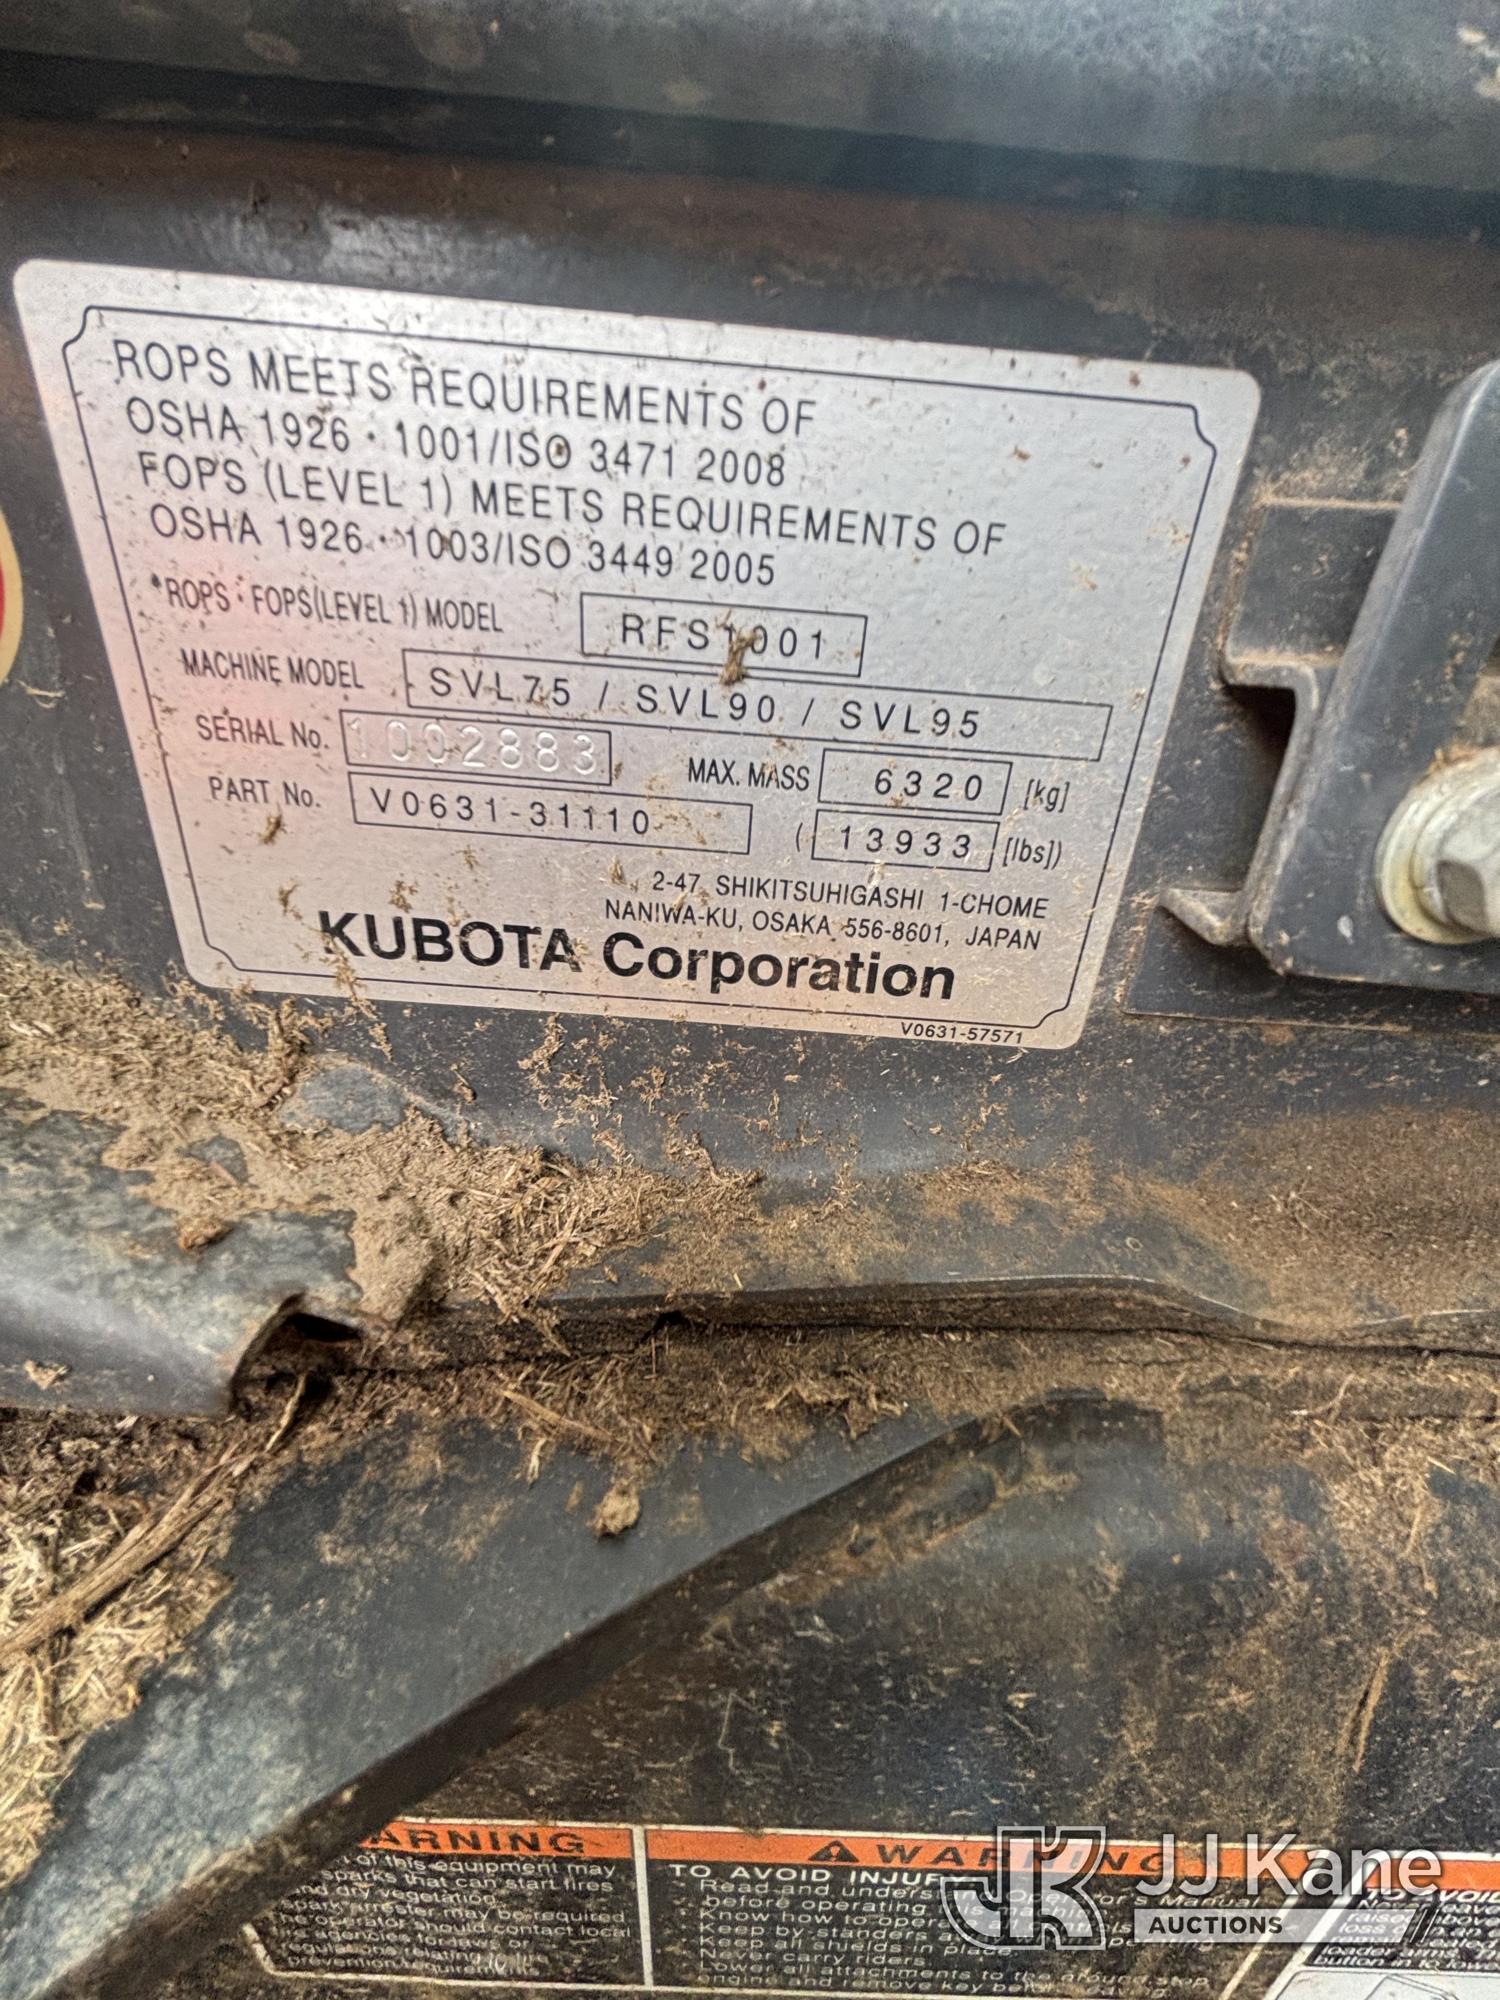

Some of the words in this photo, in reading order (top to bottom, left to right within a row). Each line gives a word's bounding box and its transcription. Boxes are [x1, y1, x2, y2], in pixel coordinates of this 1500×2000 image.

[113, 338, 232, 387] ROPS
[249, 351, 392, 401] MEETS
[411, 366, 743, 432] REQUIREMENTS
[762, 398, 817, 436] OF
[126, 396, 243, 443] OSHA
[261, 409, 351, 453] 1926
[396, 422, 572, 470] 1001/ISO
[591, 439, 675, 479] 3471
[697, 448, 786, 488] 2008
[138, 451, 247, 495] FOPS
[264, 458, 402, 507] (LEVEL
[421, 474, 452, 516] 1)
[472, 479, 604, 523] MEETS
[623, 493, 938, 552] REQUIREMENTS
[954, 520, 1007, 557] OF
[151, 503, 261, 547] OSHA
[277, 516, 362, 554] 1926
[406, 527, 571, 570] 1003/ISO
[587, 540, 673, 577] 3449
[690, 549, 776, 587] 2005
[165, 577, 231, 612] ROPS
[399, 596, 418, 630] 1)
[425, 597, 504, 634] MODEL
[180, 648, 280, 686] MACHINE
[288, 656, 364, 690] MODEL
[430, 666, 571, 707] SVL75
[637, 683, 776, 724] SVL90
[840, 700, 980, 739] SVL95
[195, 714, 284, 747] SERIAL
[291, 722, 329, 750] No.
[348, 717, 598, 775] 1002883
[688, 757, 743, 786] MAX.
[748, 762, 810, 792] MASS
[874, 768, 983, 802] 6320
[1023, 779, 1070, 813] [kg]
[208, 776, 269, 803] PART
[282, 780, 321, 810] No.
[370, 786, 650, 835] V0631-31110
[841, 826, 971, 859] 13933
[652, 870, 700, 893] 2-47
[716, 875, 924, 911] SHIKITSUHIGASHI
[940, 892, 1049, 919] 1-CHOME
[606, 899, 743, 932] NANIWA-KU,
[752, 911, 831, 936] OSAKA
[845, 917, 951, 947] 556-8601,
[965, 926, 1042, 950] JAPAN
[318, 910, 583, 973] KUBOTA
[603, 931, 955, 1000] Corporation
[901, 1021, 1023, 1045] V0631-57571
[370, 1829, 585, 1853] ARNING
[385, 1854, 426, 1870] this
[430, 1861, 558, 1876] equipment
[568, 1864, 615, 1878] may
[669, 1863, 712, 1878] TO
[730, 1866, 832, 1882] AVOID
[320, 1869, 397, 1884] sparks
[404, 1873, 448, 1888] that
[456, 1878, 497, 1889] can
[506, 1876, 557, 1891] start
[564, 1877, 613, 1892] fires
[700, 1879, 769, 1894] Read
[781, 1883, 830, 1897] and
[1159, 1894, 1261, 1908] Manual
[443, 1906, 490, 1921] may
[533, 1909, 625, 1924] required
[700, 1908, 770, 1922] Know
[782, 1911, 833, 1924] how
[844, 1914, 868, 1926] to
[703, 1894, 790, 1909] before
[801, 1899, 927, 1916] operating
[493, 1924, 574, 1938] contact
[580, 1926, 632, 1938] local
[700, 1922, 765, 1937] Keep
[700, 1935, 764, 1950] Keep
[775, 1937, 802, 1950] all
[813, 1939, 902, 1953] shields
[913, 1943, 934, 1953] in
[700, 1948, 772, 1961] Never
[783, 1952, 846, 1966] carry
[1321, 1944, 1394, 1957] loader
[820, 1964, 971, 1980] attachments
[942, 1980, 983, 1994] key
